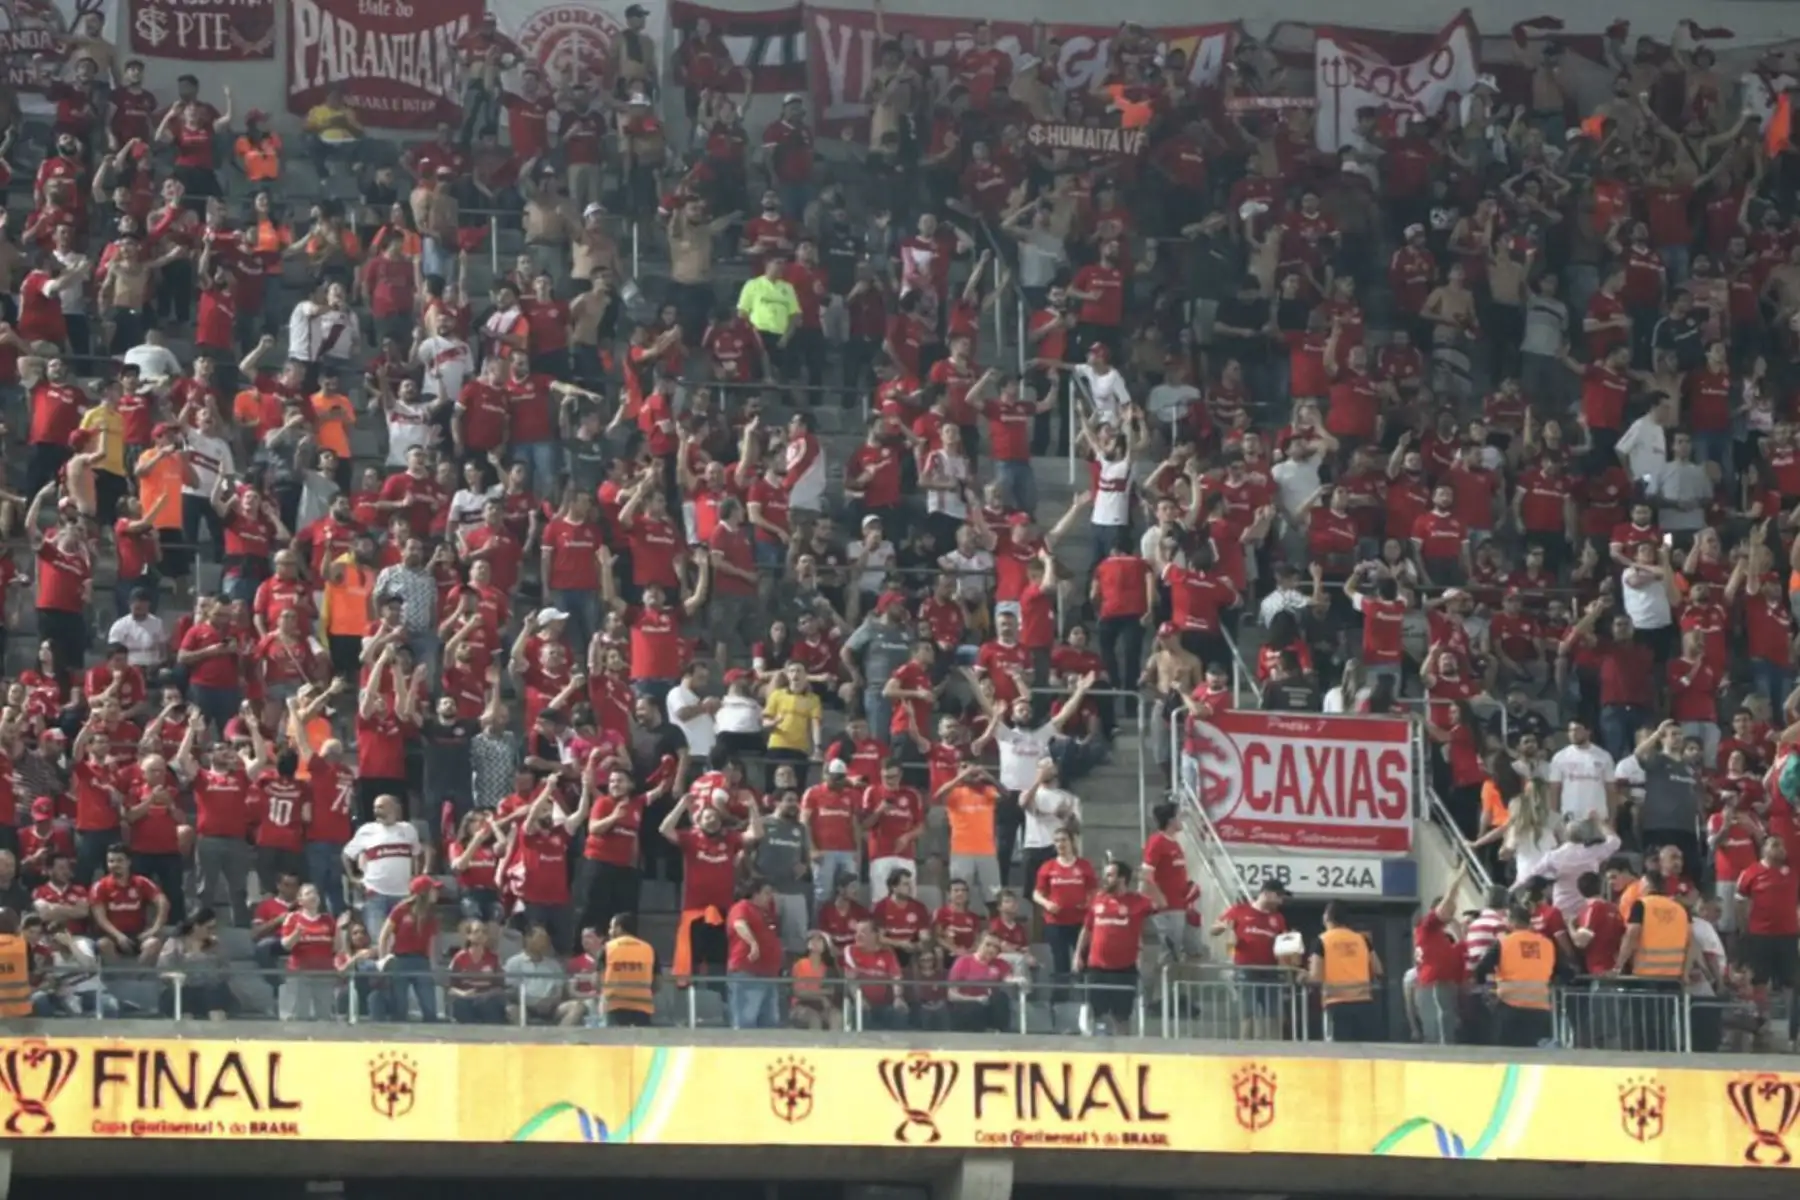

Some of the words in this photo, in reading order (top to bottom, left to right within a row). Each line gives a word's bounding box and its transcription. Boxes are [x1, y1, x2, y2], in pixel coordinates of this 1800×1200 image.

[173, 10, 231, 50] PTE
[520, 8, 619, 52] ALVORAD
[1316, 719, 1328, 733] 7
[1242, 742, 1408, 820] CAXIAS
[268, 796, 293, 827] 10
[1316, 865, 1376, 888] 324A
[93, 1049, 301, 1110] FINAL
[973, 1062, 1169, 1121] FINAL
[249, 1121, 299, 1135] BRASIL
[1122, 1131, 1170, 1146] BRASIL
